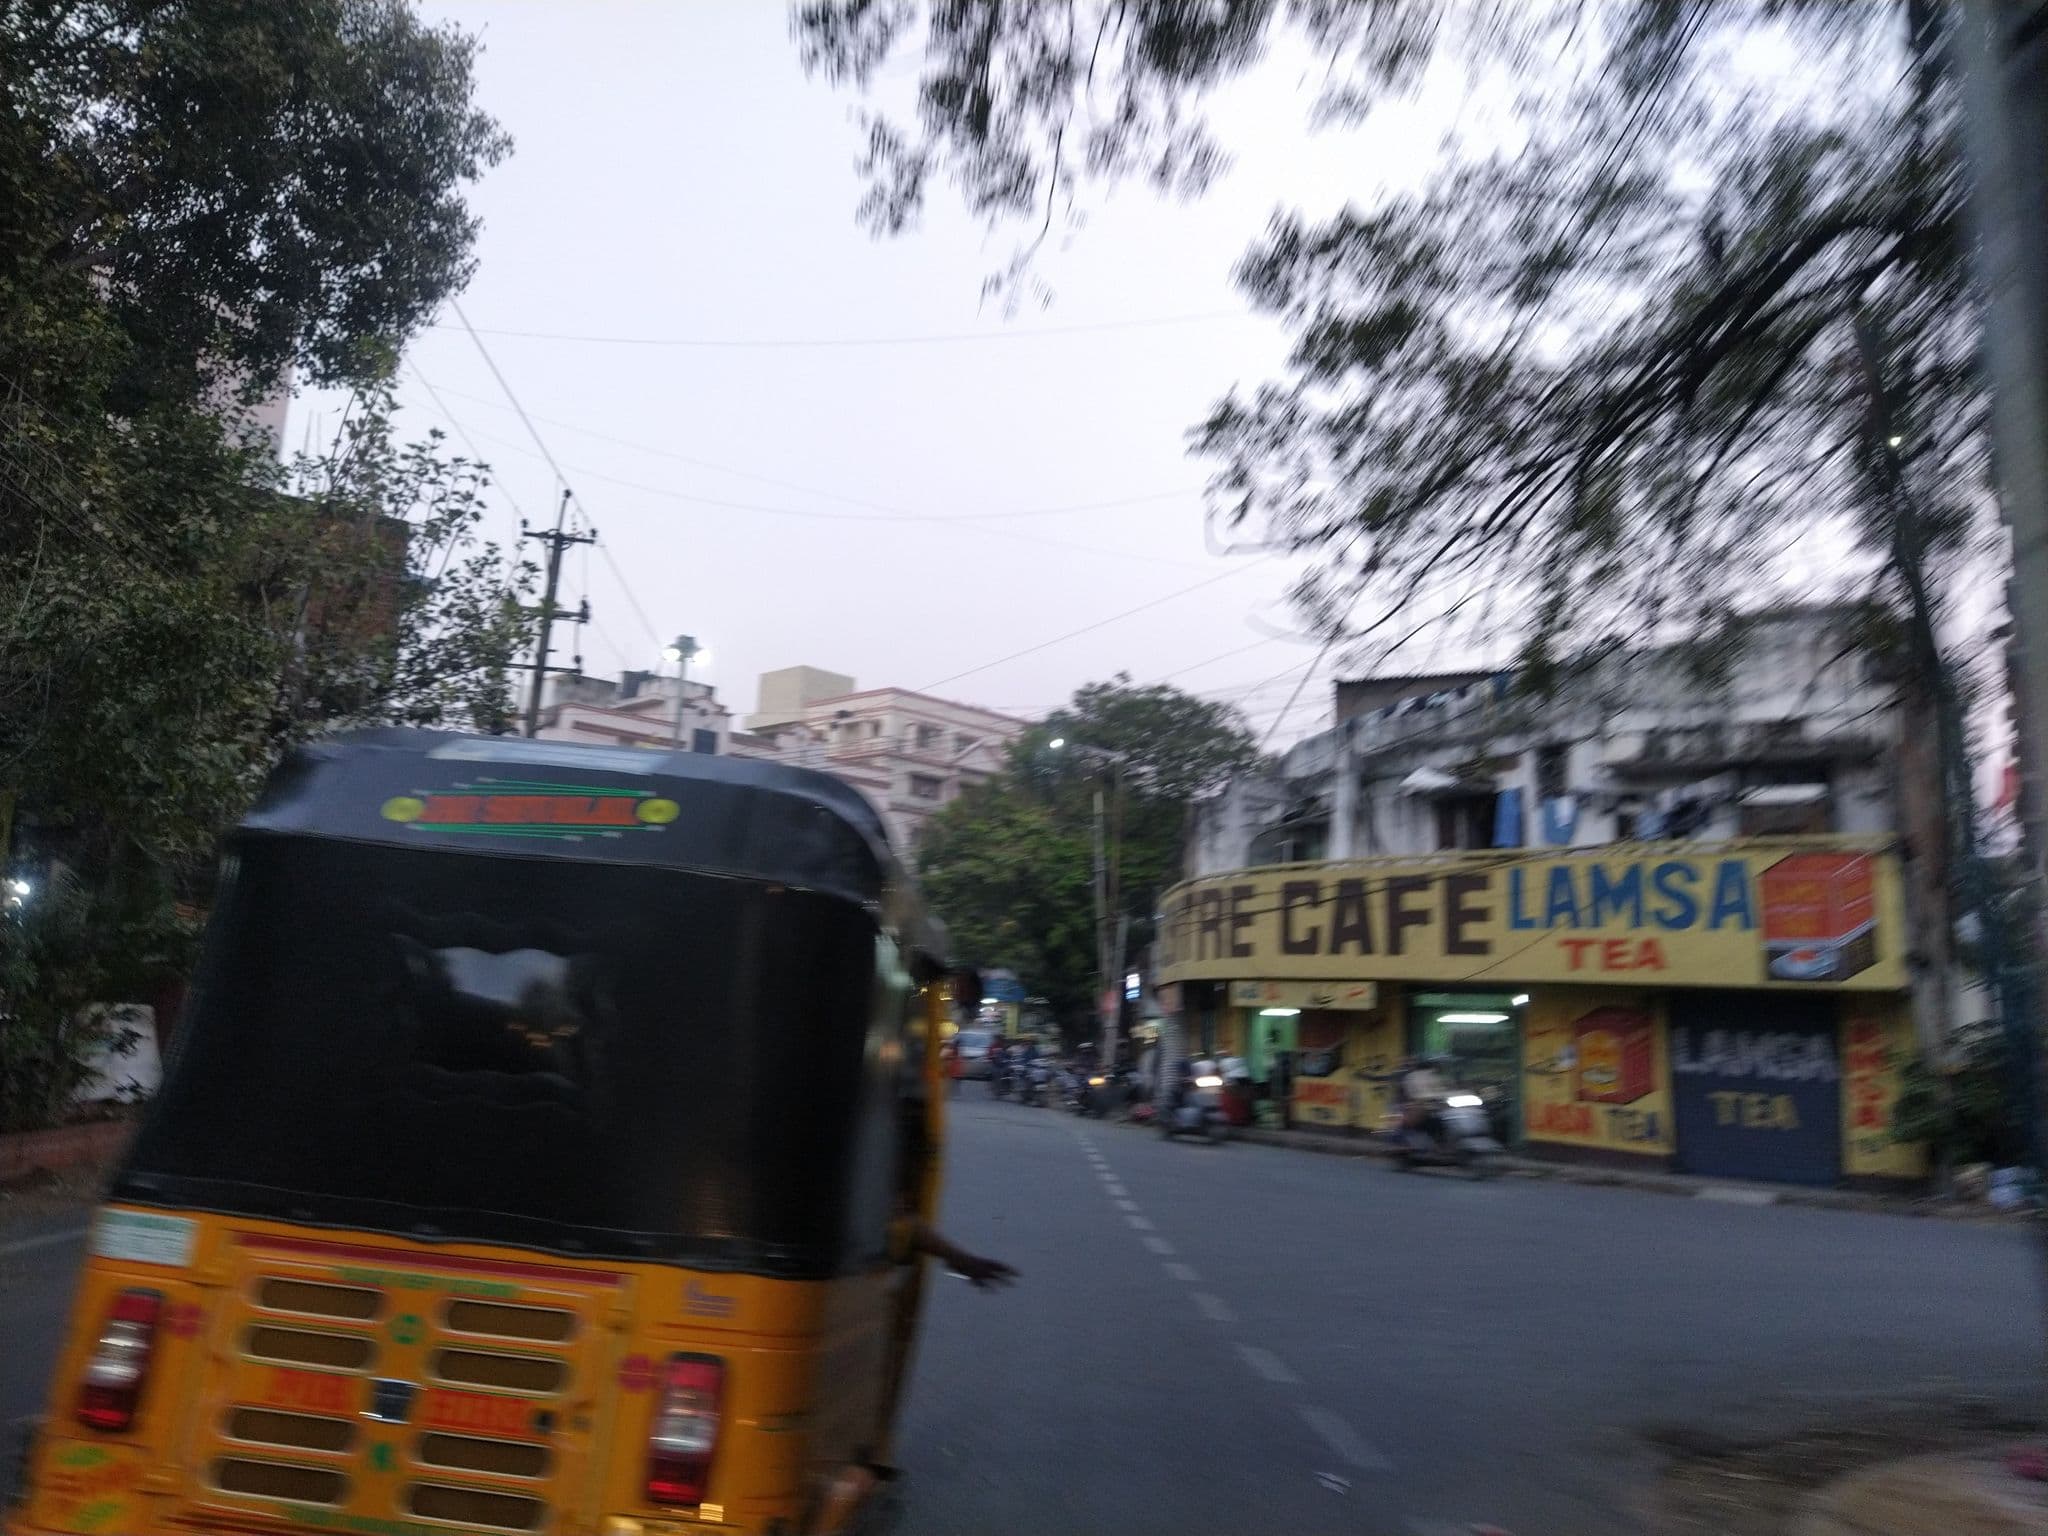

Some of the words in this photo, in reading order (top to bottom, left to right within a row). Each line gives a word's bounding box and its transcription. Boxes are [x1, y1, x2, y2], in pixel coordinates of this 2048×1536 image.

[1281, 874, 1493, 956] CAFE
[1508, 860, 1758, 932] LAMSA
[1560, 938, 1668, 971] TEA
